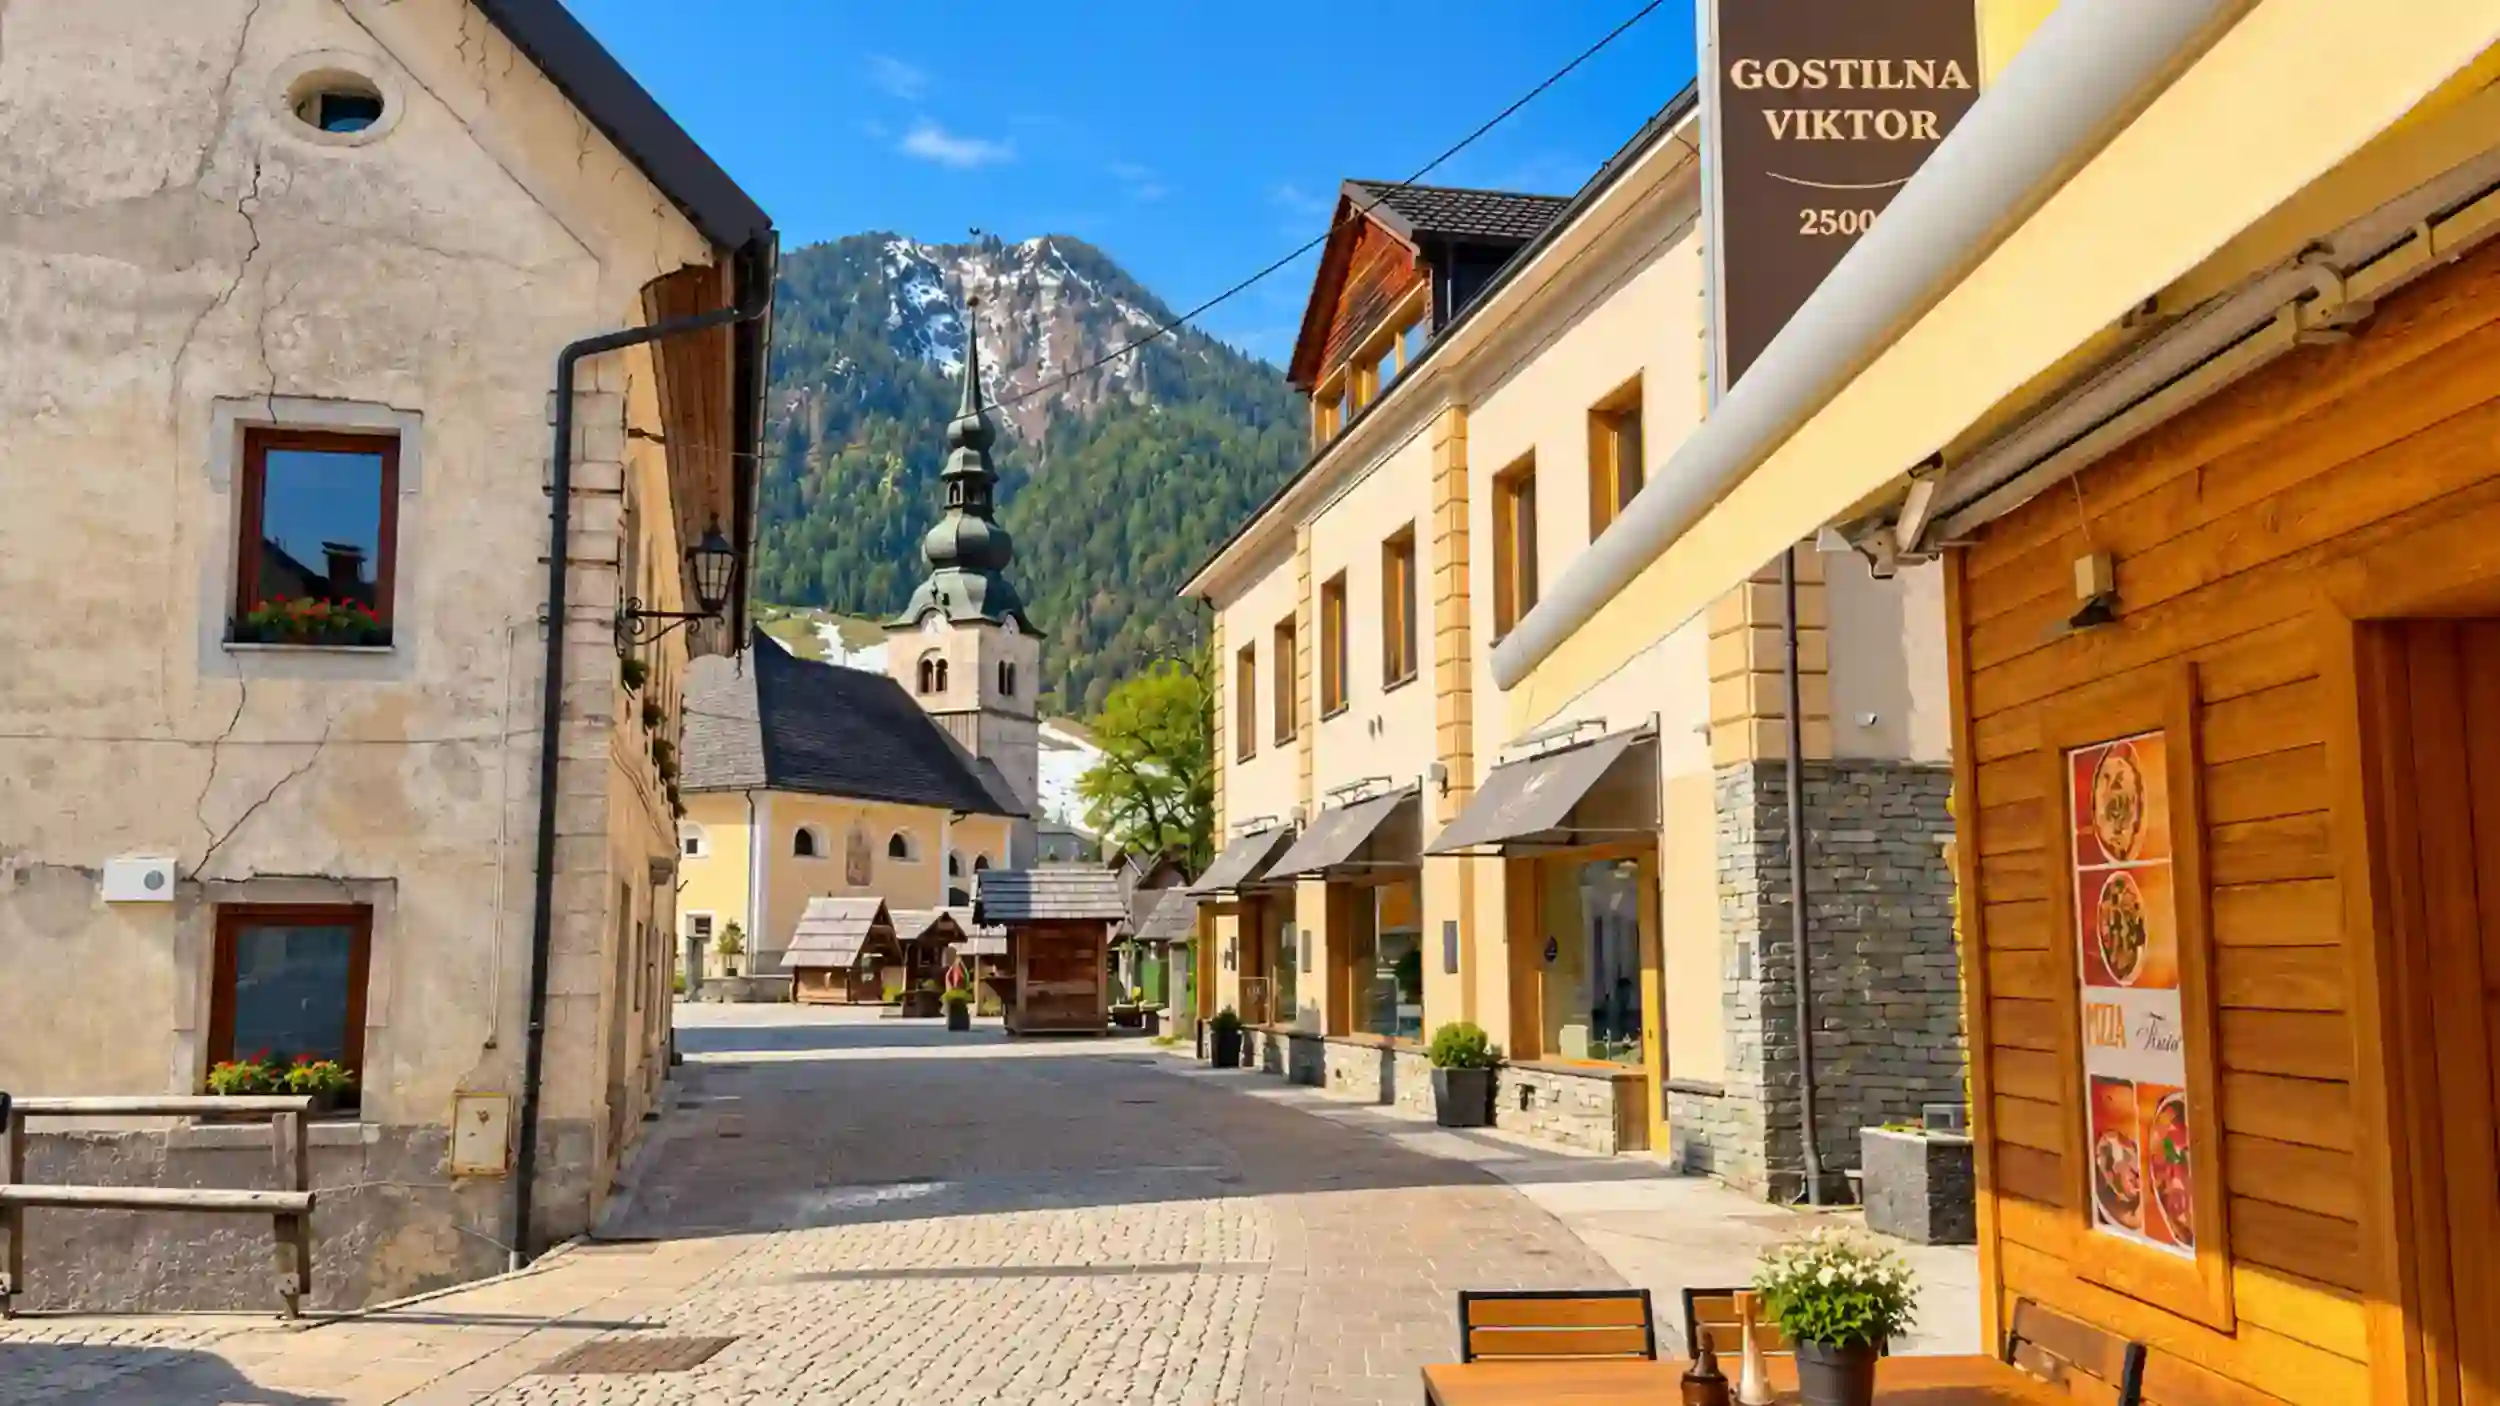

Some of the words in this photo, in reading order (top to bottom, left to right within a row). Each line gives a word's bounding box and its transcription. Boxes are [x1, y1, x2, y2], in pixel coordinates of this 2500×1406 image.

[1730, 58, 1972, 90] GOSTILNA
[1763, 109, 1941, 141] VIKTOR
[2087, 1003, 2127, 1049] PIZZA
